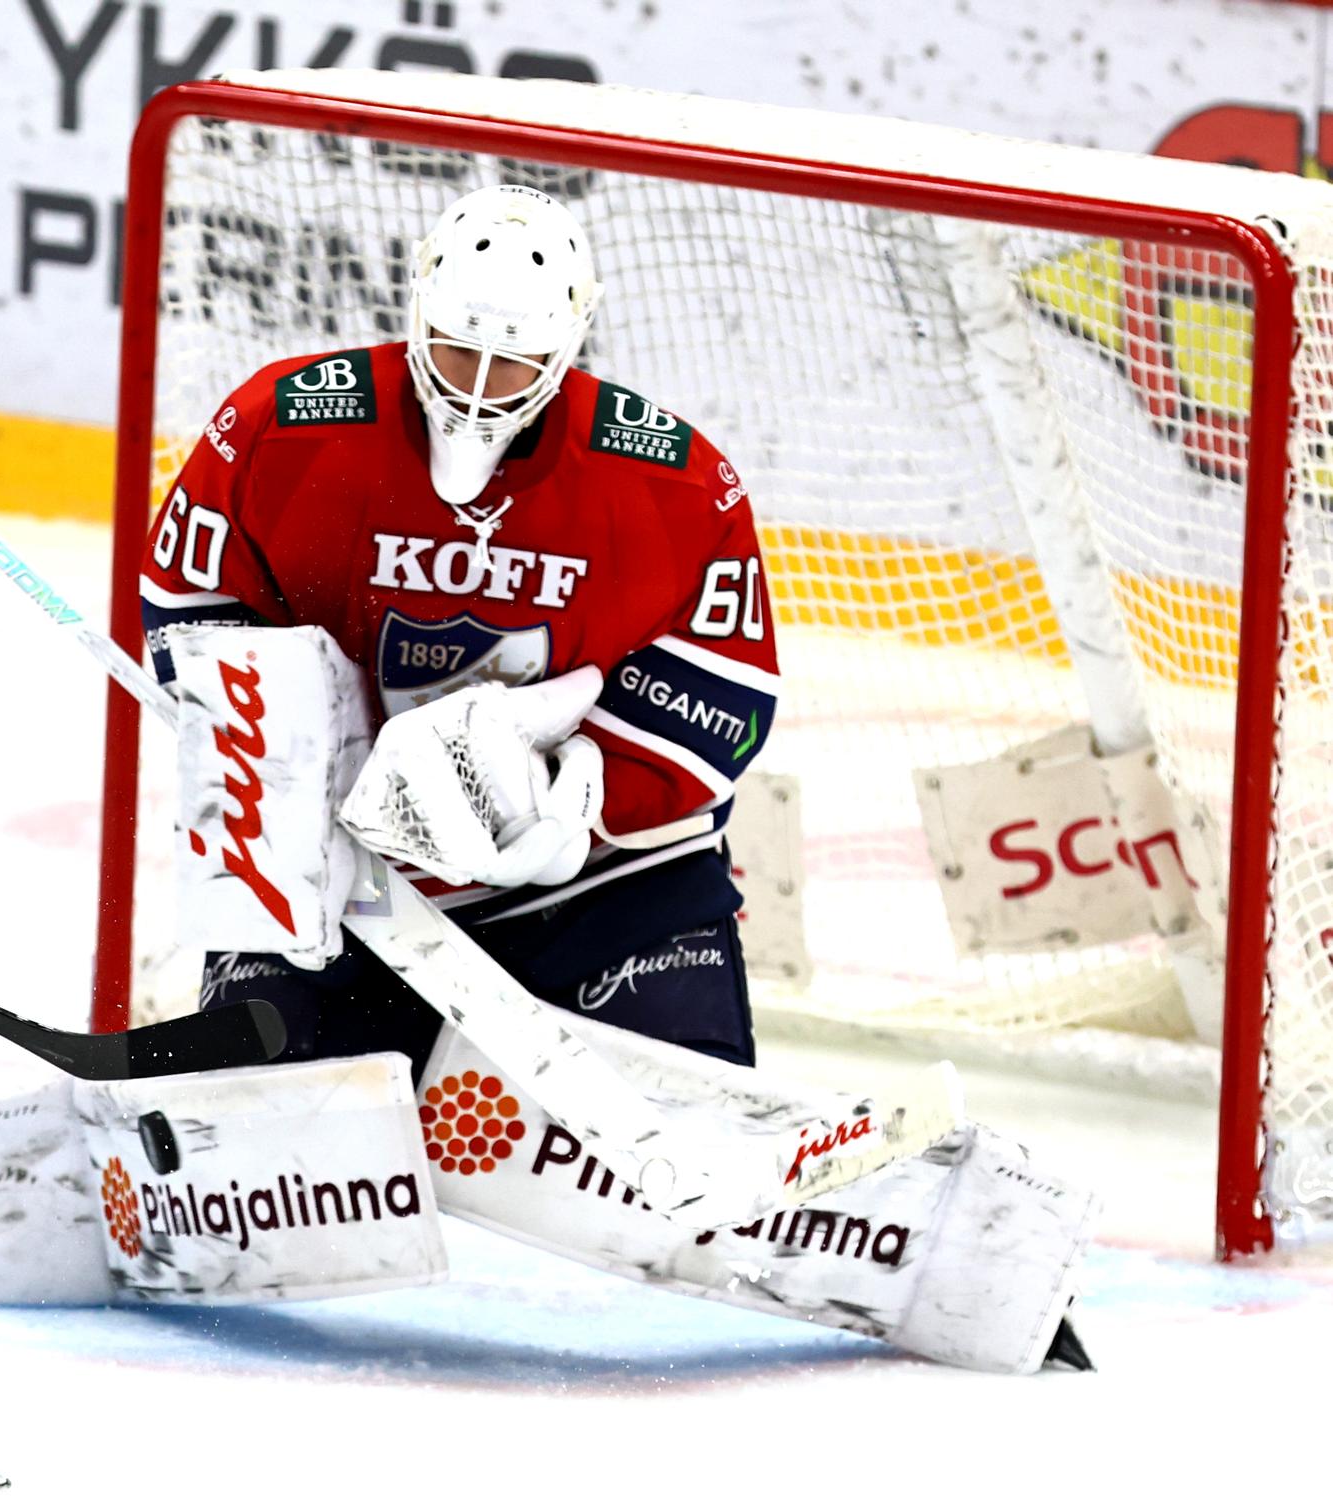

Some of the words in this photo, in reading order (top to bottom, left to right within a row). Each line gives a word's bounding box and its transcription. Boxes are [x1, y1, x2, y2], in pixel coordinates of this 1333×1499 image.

[288, 408, 366, 421] BANKERS
[294, 397, 359, 410] UNITED
[609, 428, 672, 449] UNITED
[601, 437, 677, 462] BANKERS
[153, 484, 230, 592] 60
[369, 533, 588, 608] KOFF
[689, 555, 764, 641] 60
[398, 640, 465, 671] 1897
[620, 665, 746, 744] GIGANTTI
[189, 659, 297, 937] jura
[783, 1116, 870, 1186] jura
[140, 1173, 421, 1251] Pihlajalinna
